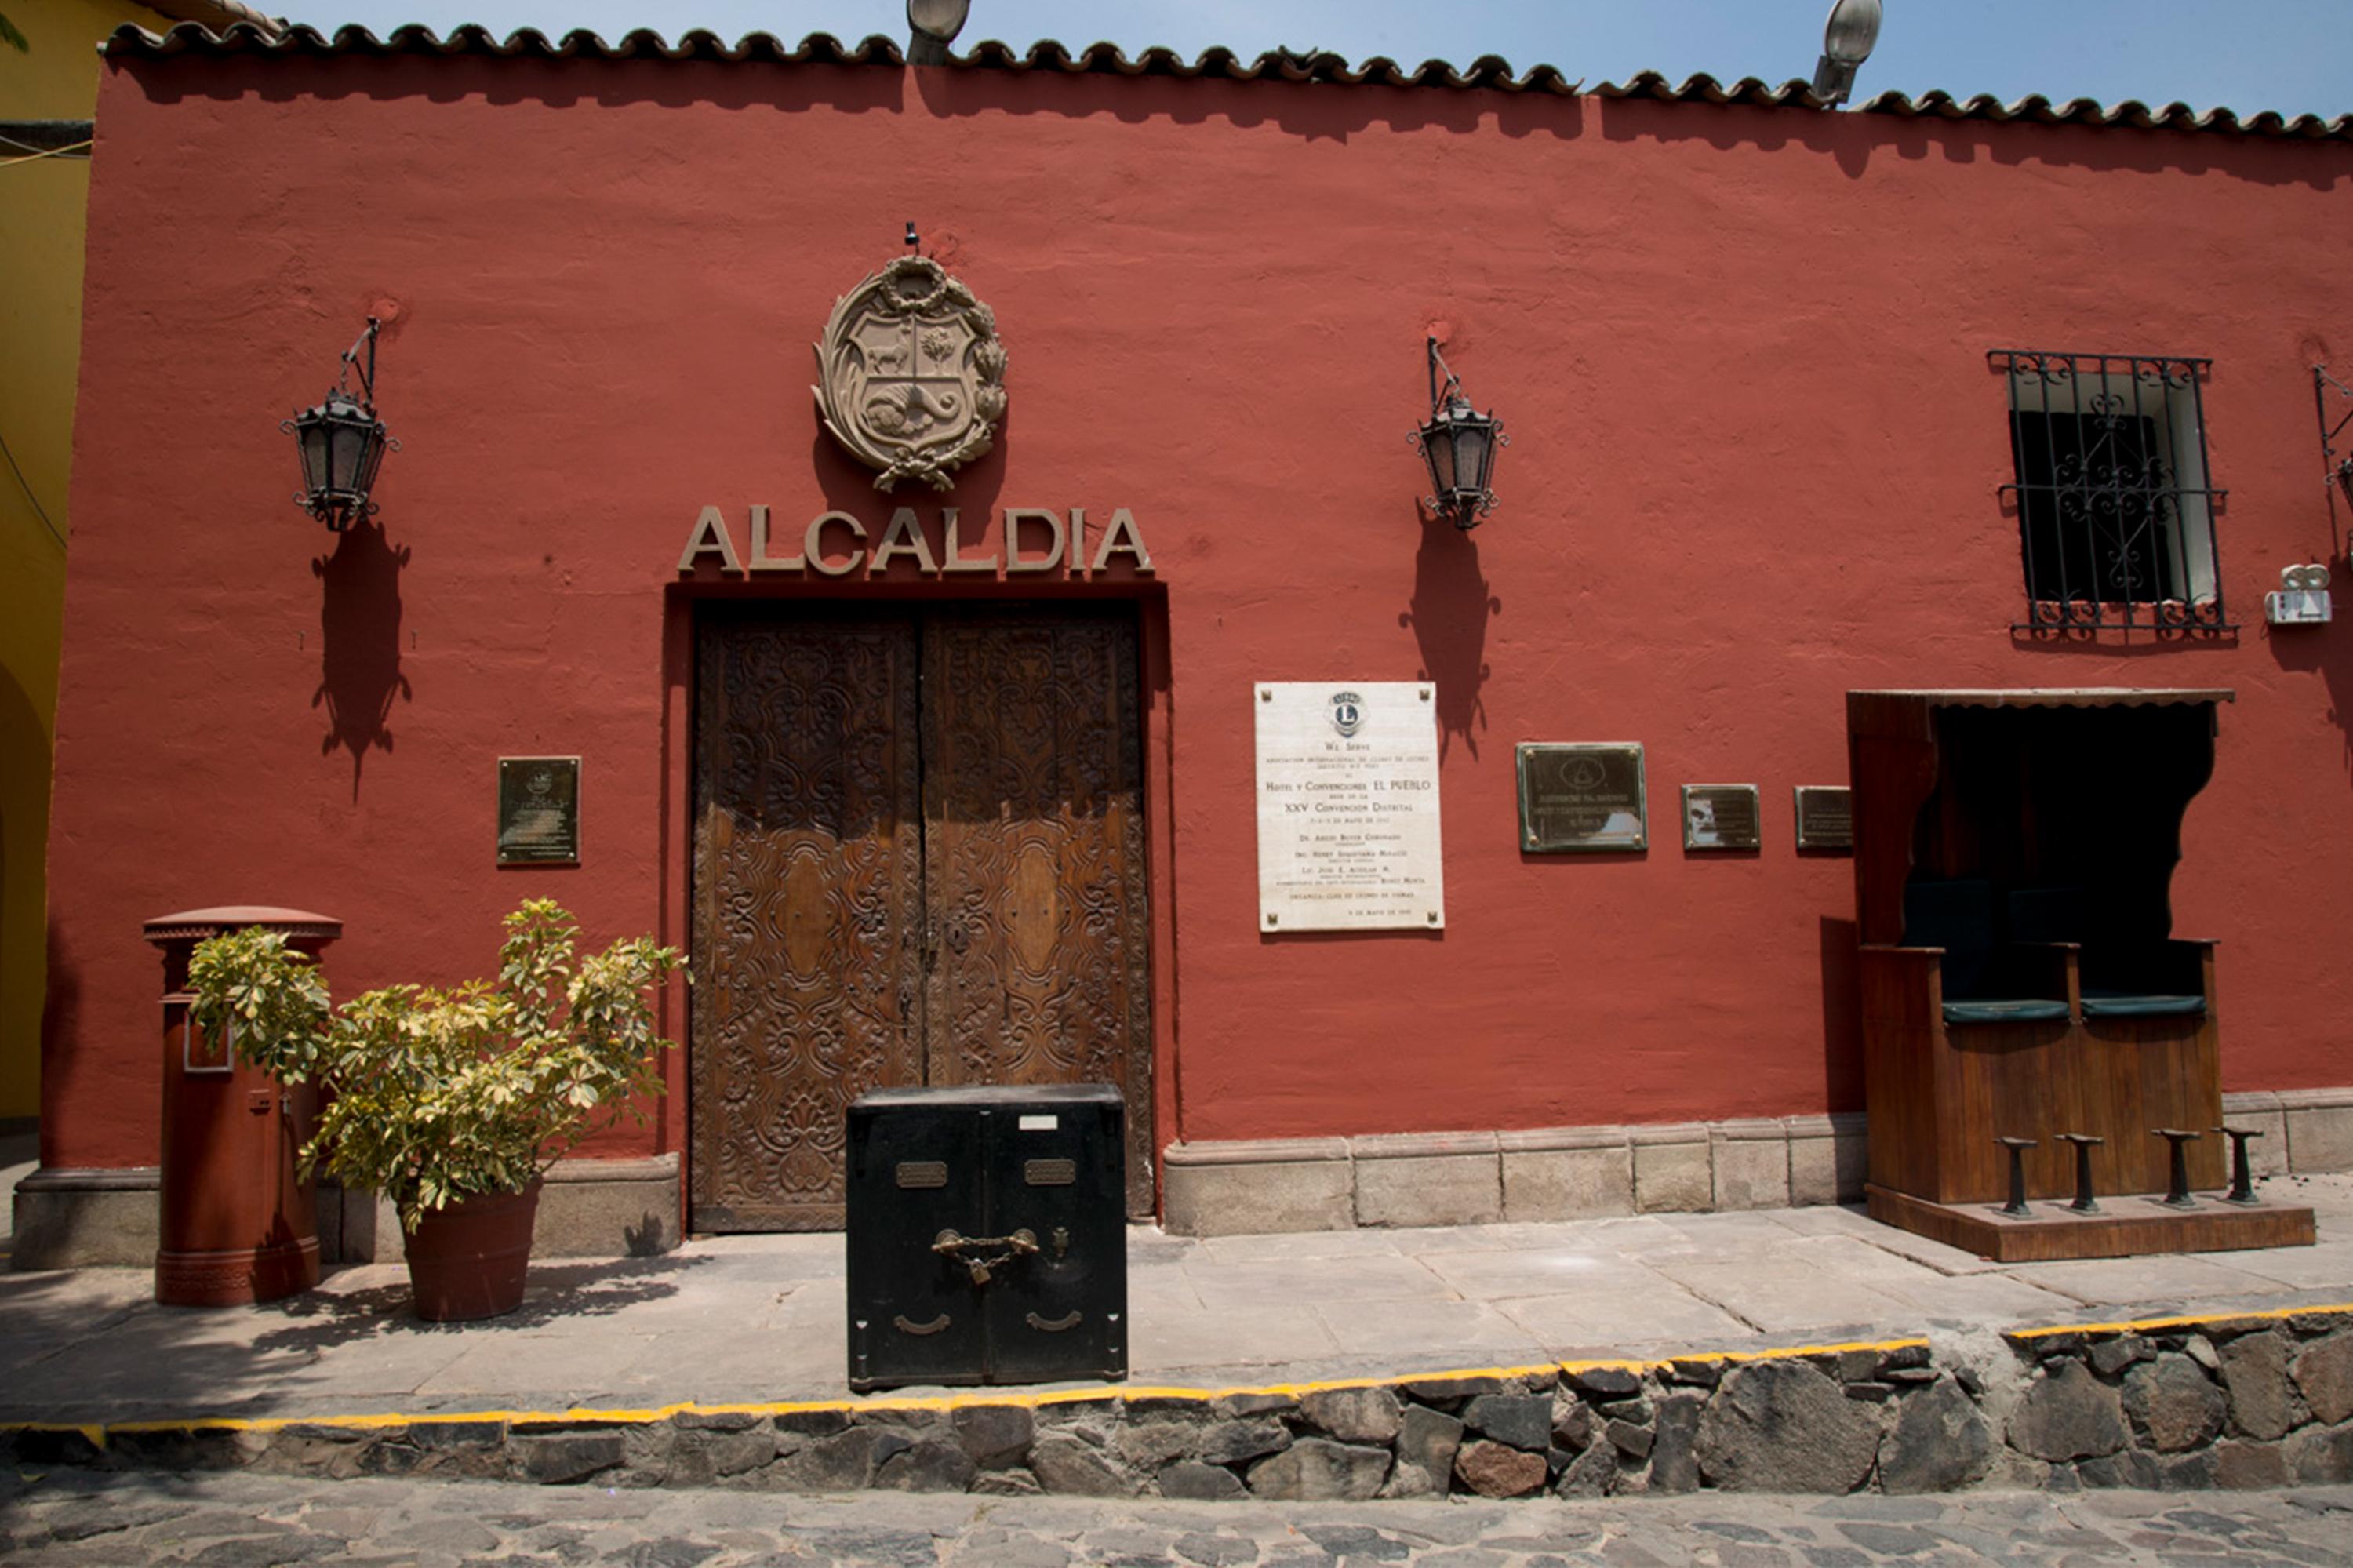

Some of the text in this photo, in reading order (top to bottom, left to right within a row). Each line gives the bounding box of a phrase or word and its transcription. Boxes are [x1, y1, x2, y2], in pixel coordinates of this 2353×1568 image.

[677, 504, 1155, 576] ALCALDIA
[1341, 705, 1355, 722] L
[1266, 782, 1293, 791] HOTEL
[1305, 781, 1366, 791] CONVENCIONES
[1374, 780, 1385, 791] EL
[1391, 780, 1431, 791] PUEBLO
[1286, 802, 1413, 813] XXV CONVENCION DISTRITAL
